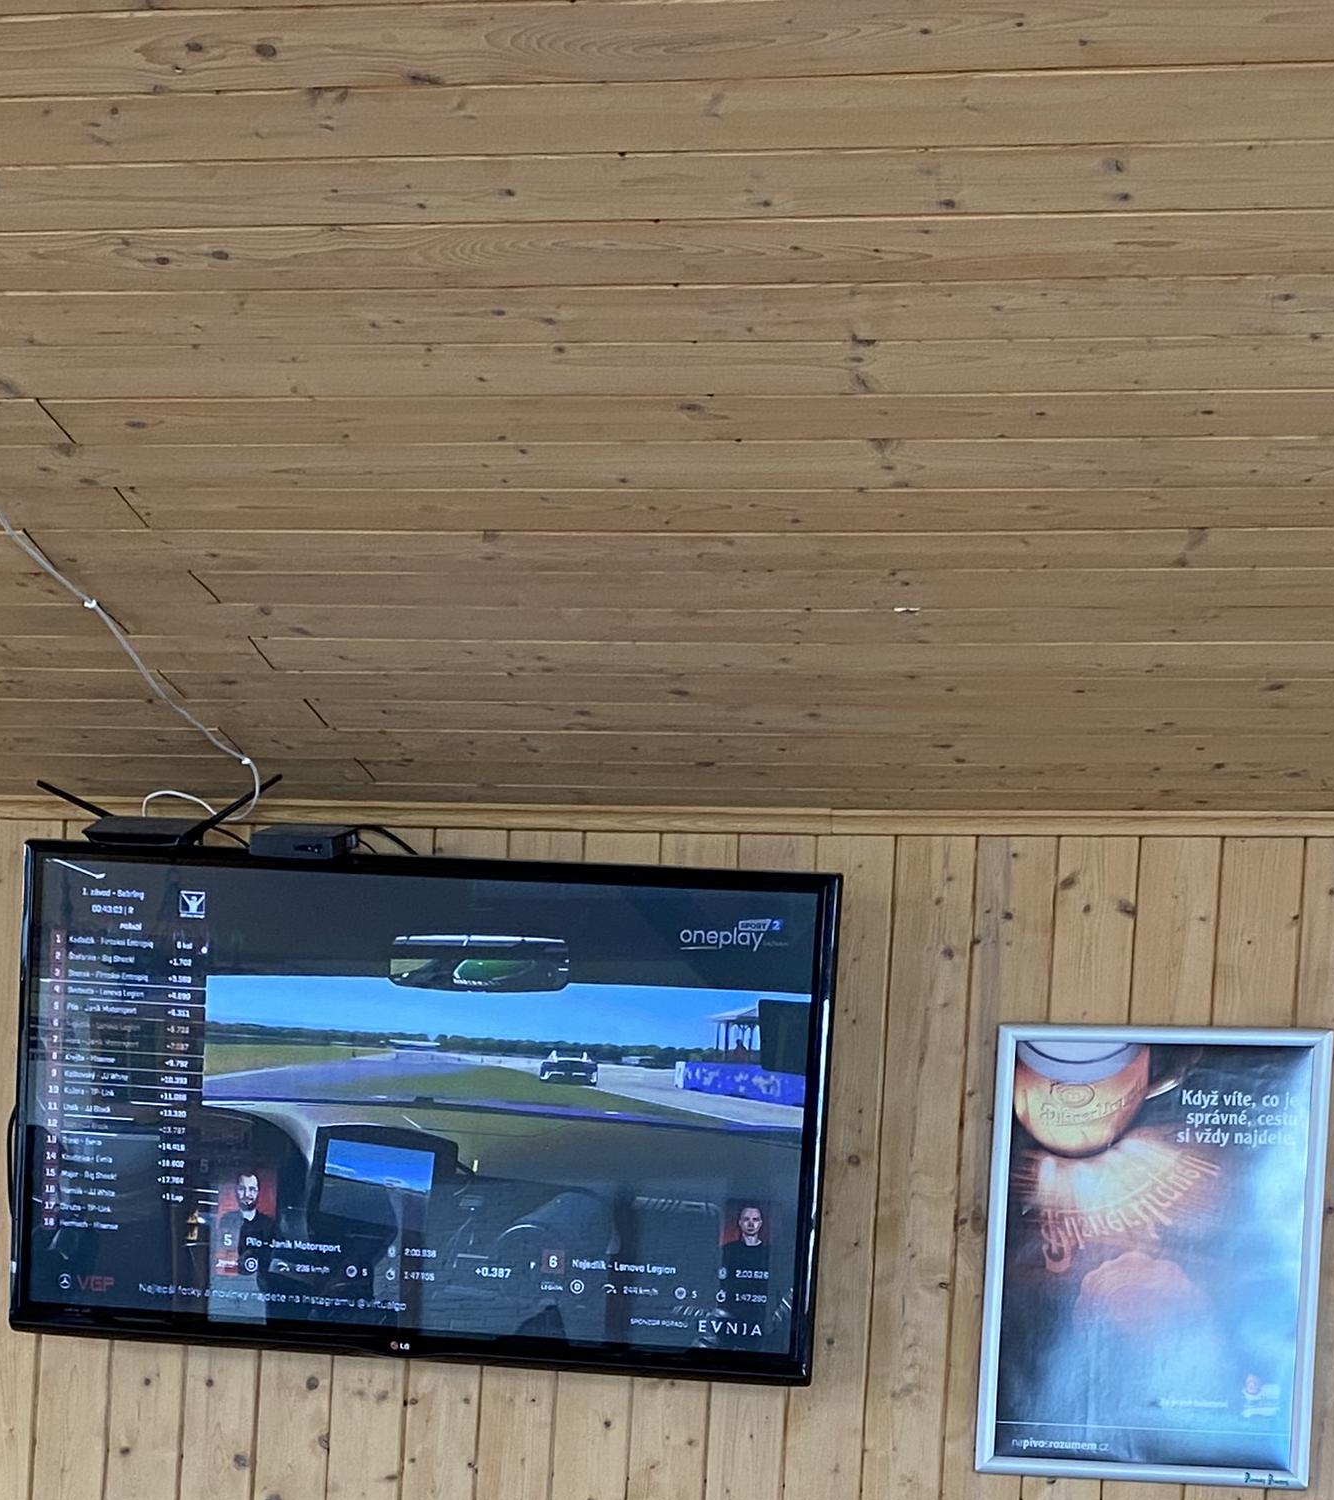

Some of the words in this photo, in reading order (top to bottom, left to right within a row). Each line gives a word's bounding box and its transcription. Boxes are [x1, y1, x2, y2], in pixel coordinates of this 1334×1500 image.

[740, 922, 767, 930] SPORT
[771, 920, 781, 930] 2
[55, 934, 61, 943] 1
[679, 927, 763, 952] oneplay
[55, 952, 61, 960] 2
[53, 1035, 58, 1043] 7
[48, 1085, 59, 1094] 10
[1181, 1090, 1219, 1109] Když
[1223, 1090, 1257, 1109] víte,
[1261, 1094, 1279, 1108] co
[1284, 1092, 1300, 1111] je
[47, 1102, 59, 1111] 11
[47, 1119, 58, 1128] 12
[1187, 1110, 1252, 1128] správné,
[1257, 1113, 1299, 1126] cestu
[47, 1136, 57, 1144] 13
[1176, 1128, 1190, 1143] si
[1195, 1128, 1230, 1148] vždy
[45, 1152, 57, 1160] 14
[45, 1168, 56, 1176] 15
[45, 1184, 55, 1193] 16
[44, 1202, 55, 1210] 17
[43, 1218, 55, 1226] 18
[223, 1234, 233, 1246] 5
[293, 1240, 342, 1254] Motorsport
[549, 1255, 558, 1268] 6
[311, 1264, 331, 1274] km/h
[475, 1266, 513, 1279] +0.387
[614, 1262, 645, 1272] Lenovo
[647, 1264, 677, 1276] Legion
[76, 1274, 115, 1292] VGP
[639, 1286, 659, 1296] km/h
[288, 1294, 300, 1303] na
[697, 1320, 763, 1336] EVNIA
[399, 1342, 410, 1350] LG
[1011, 1436, 1109, 1452] napivosrozumem.cz
